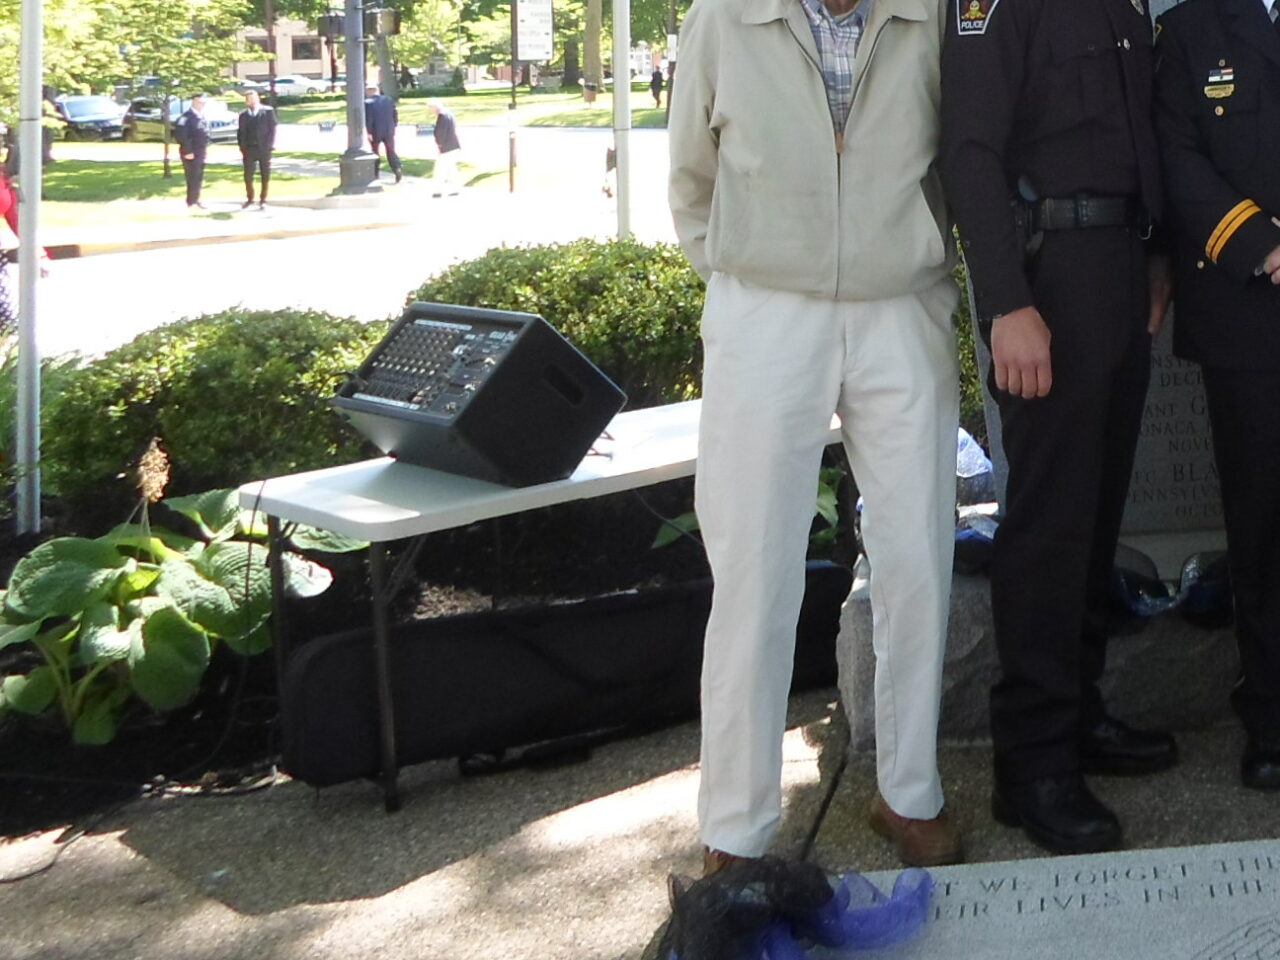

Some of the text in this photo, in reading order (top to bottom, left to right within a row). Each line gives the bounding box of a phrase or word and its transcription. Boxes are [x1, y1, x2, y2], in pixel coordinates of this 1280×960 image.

[961, 20, 983, 29] POLICE
[980, 875, 1032, 895] WE
[1053, 862, 1191, 889] FORGET
[1017, 890, 1121, 916] LIVES
[1144, 885, 1180, 904] IN
[1202, 878, 1275, 898] THE
